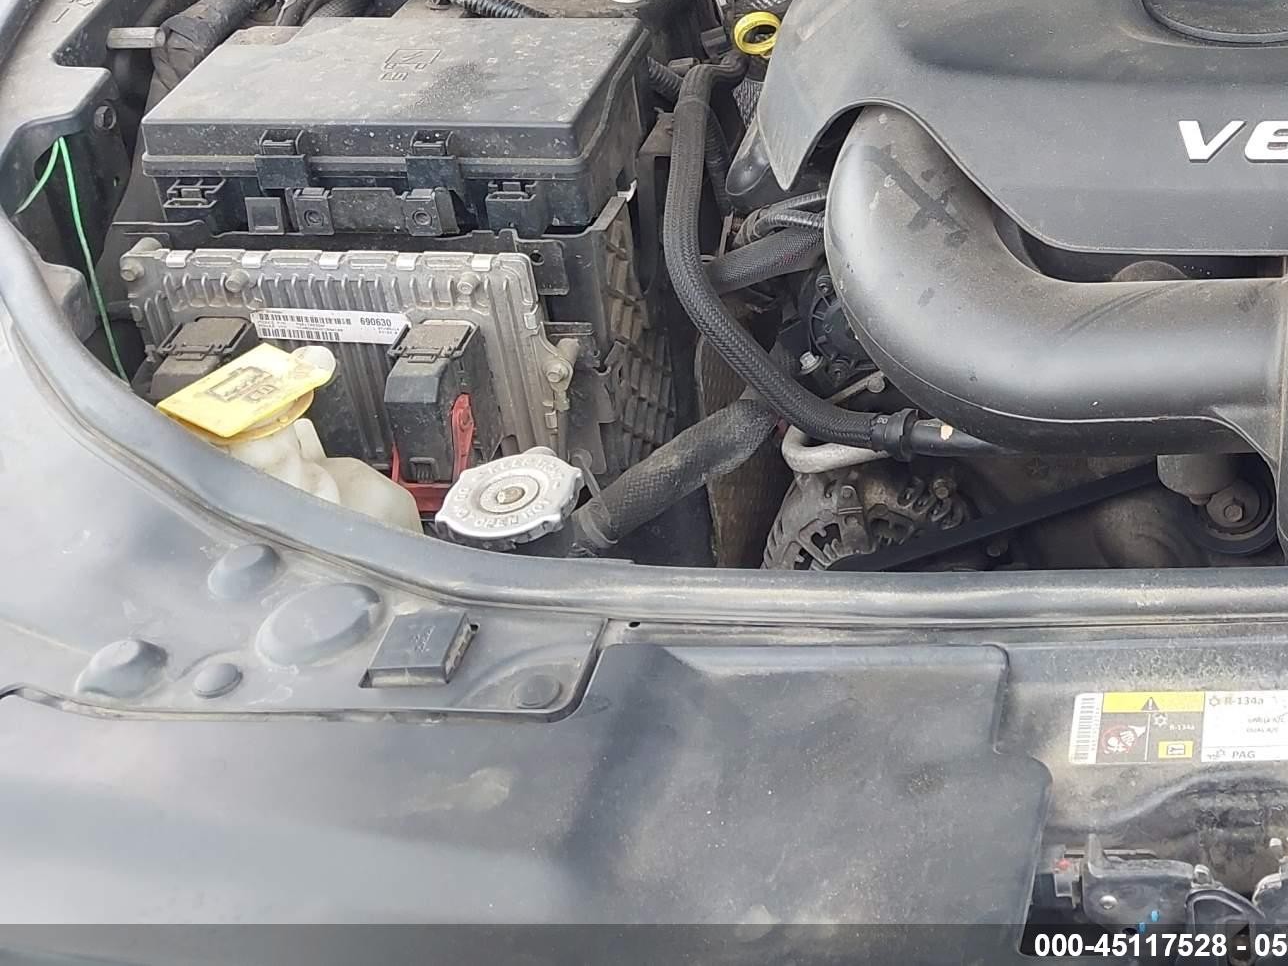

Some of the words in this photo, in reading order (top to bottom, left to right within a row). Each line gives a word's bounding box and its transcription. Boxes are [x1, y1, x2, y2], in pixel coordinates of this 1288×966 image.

[360, 316, 392, 328] 690630
[1224, 696, 1264, 705] R-134a
[1232, 749, 1256, 759] PAG
